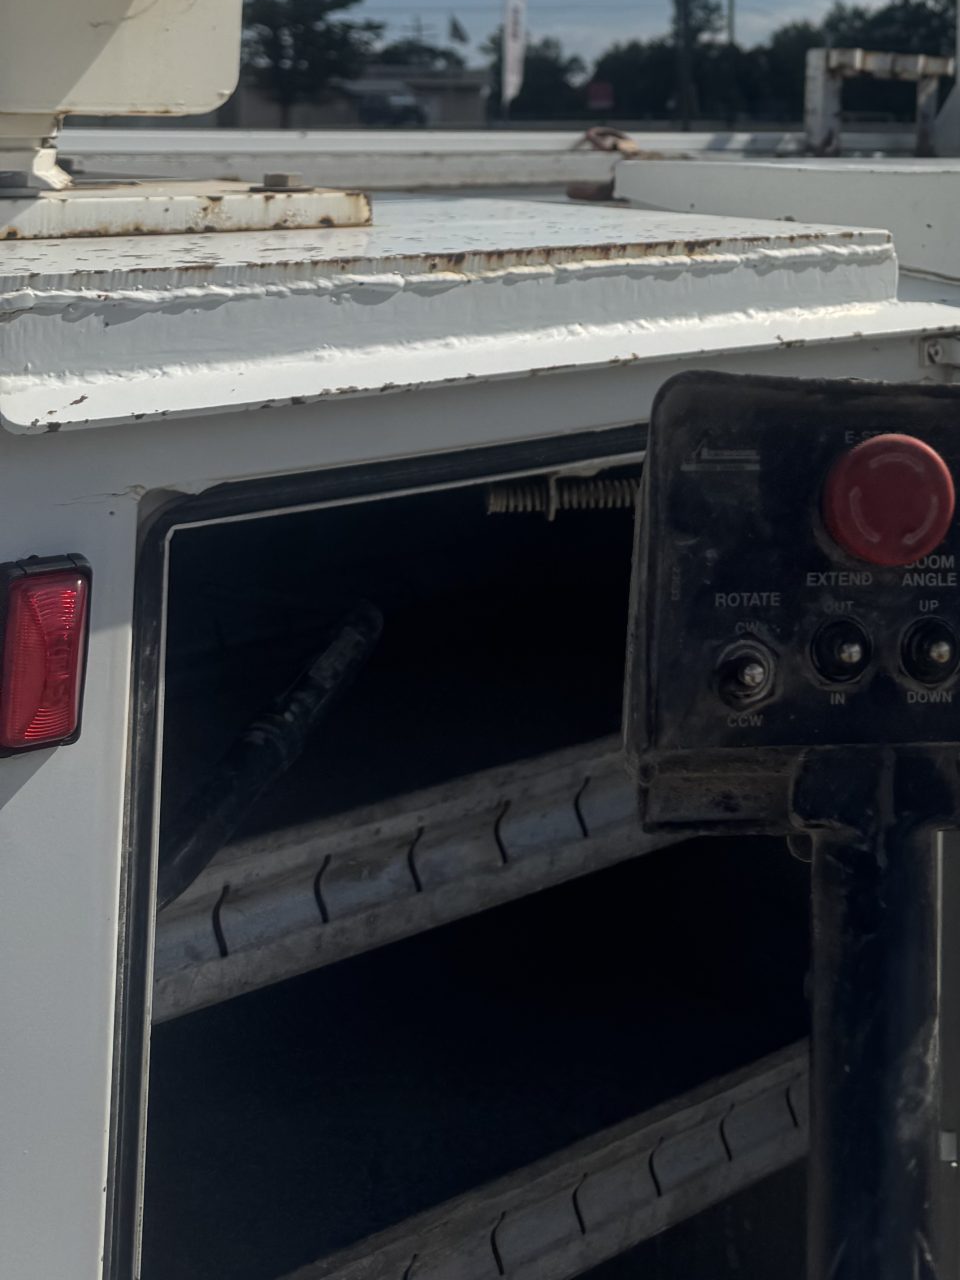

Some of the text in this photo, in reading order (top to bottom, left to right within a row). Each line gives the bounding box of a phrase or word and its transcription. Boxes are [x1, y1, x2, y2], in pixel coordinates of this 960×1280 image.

[806, 571, 873, 587] EXTEND
[901, 572, 958, 587] ANGLE
[714, 592, 781, 608] ROTATE
[823, 600, 854, 613] OUT
[919, 599, 939, 612] UP
[735, 621, 760, 634] CW
[829, 692, 846, 705] IN
[907, 691, 953, 704] DOWN
[727, 714, 764, 728] CCW
